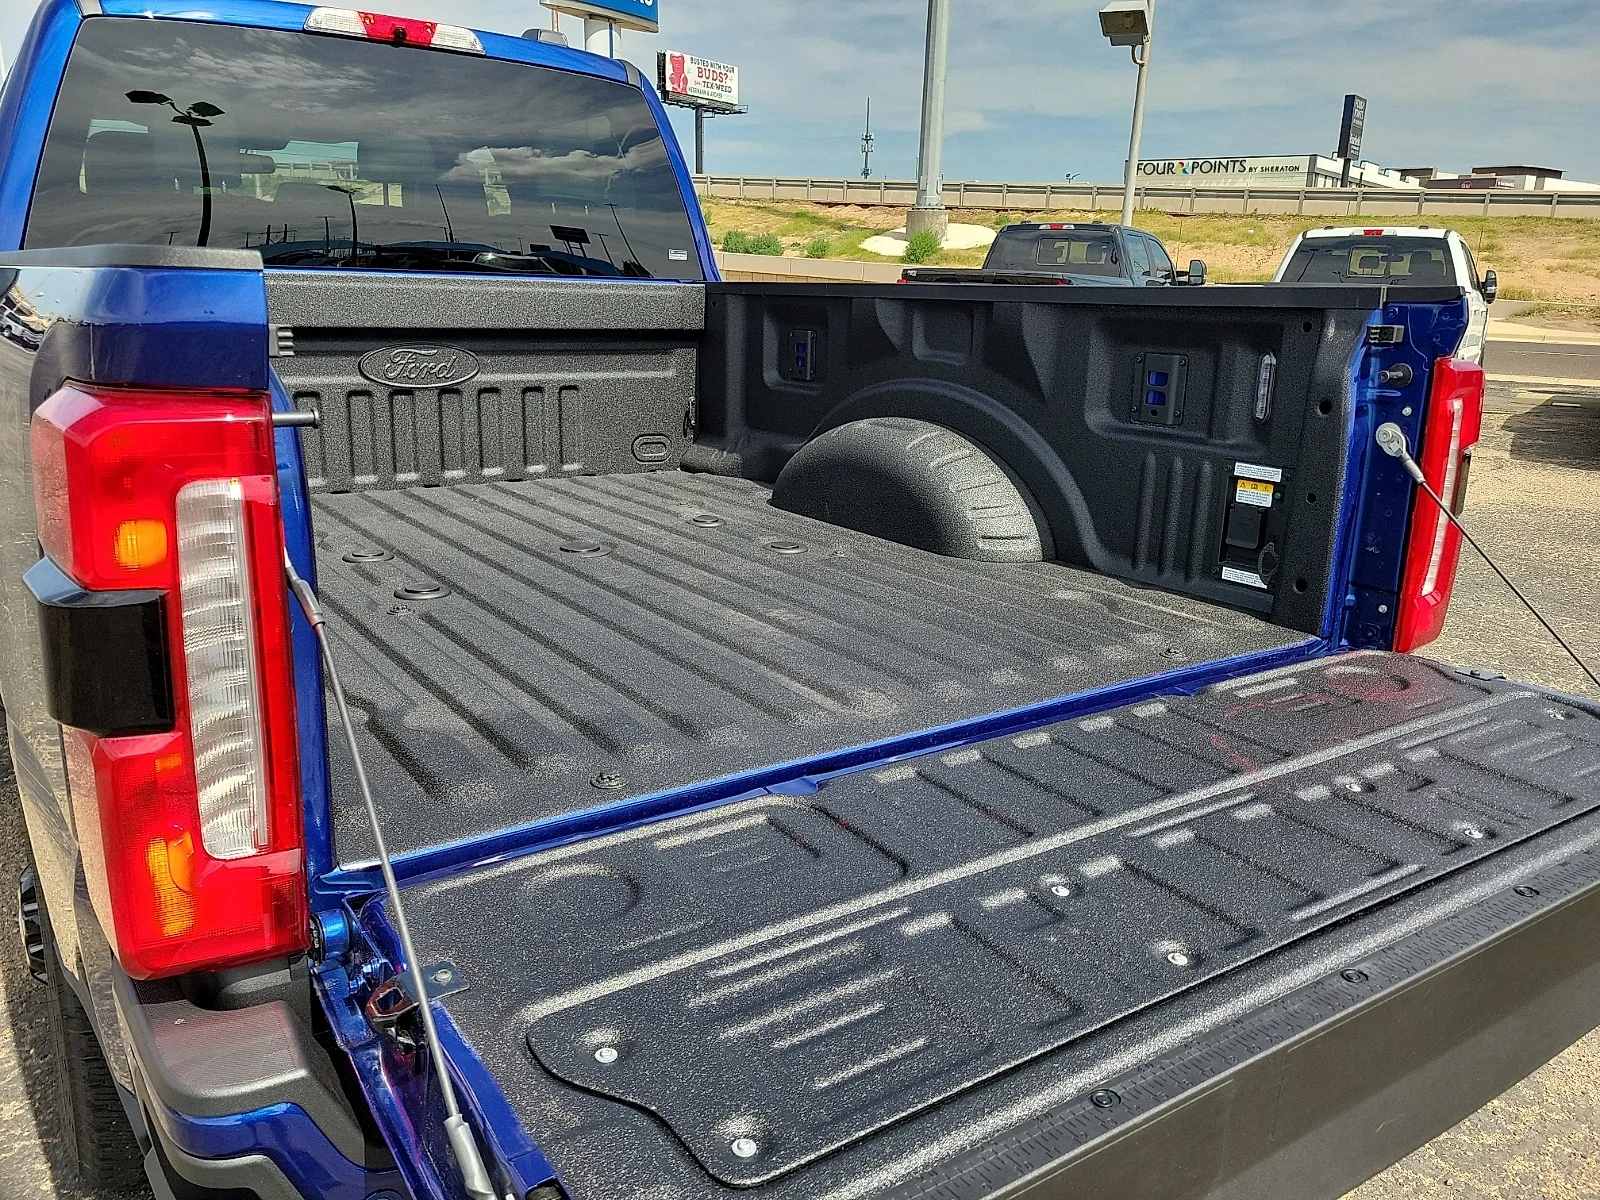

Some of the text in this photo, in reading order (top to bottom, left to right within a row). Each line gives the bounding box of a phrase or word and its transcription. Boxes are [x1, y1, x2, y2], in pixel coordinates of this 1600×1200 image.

[690, 57, 709, 67] BUSTED
[710, 61, 721, 70] WITH
[697, 67, 729, 84] BUDS?
[702, 81, 732, 93] TEX-WEED
[1136, 162, 1176, 176] FOUR
[1191, 160, 1246, 174] POINTS
[1260, 165, 1300, 173] SHERATON
[384, 348, 458, 379] Ford
